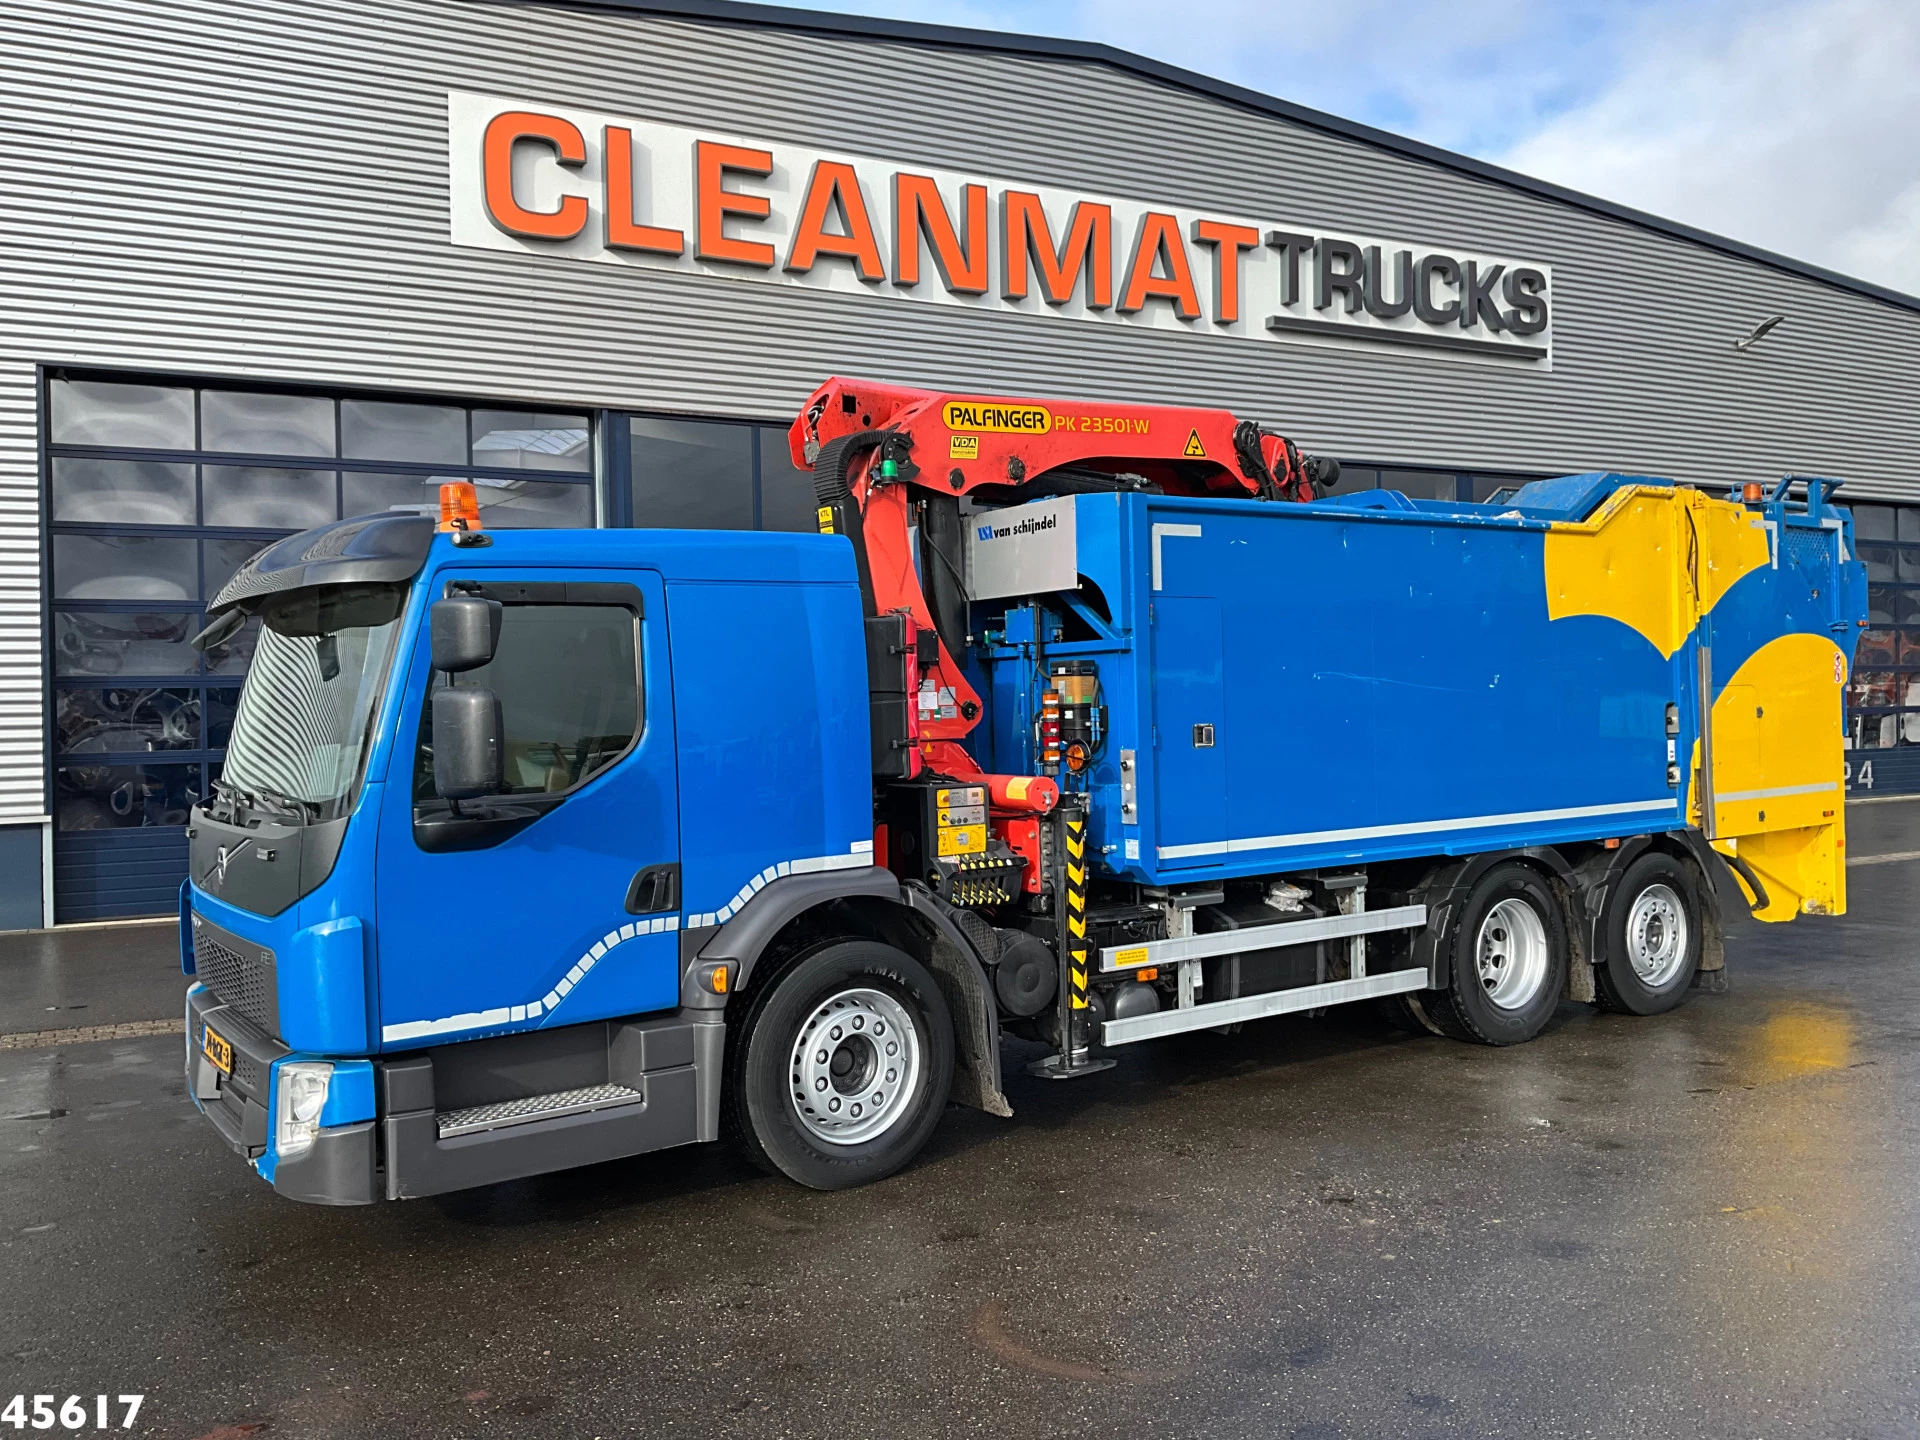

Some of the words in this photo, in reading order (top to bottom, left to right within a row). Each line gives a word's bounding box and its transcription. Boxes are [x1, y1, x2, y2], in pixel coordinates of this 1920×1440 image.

[483, 111, 1259, 325] CLEANMAT
[1265, 230, 1548, 335] TRUCKS
[949, 406, 1045, 430] PALFINGER
[1054, 415, 1076, 431] PK
[953, 436, 977, 449] VDA
[993, 526, 1011, 539] van
[1013, 513, 1057, 535] schijndel
